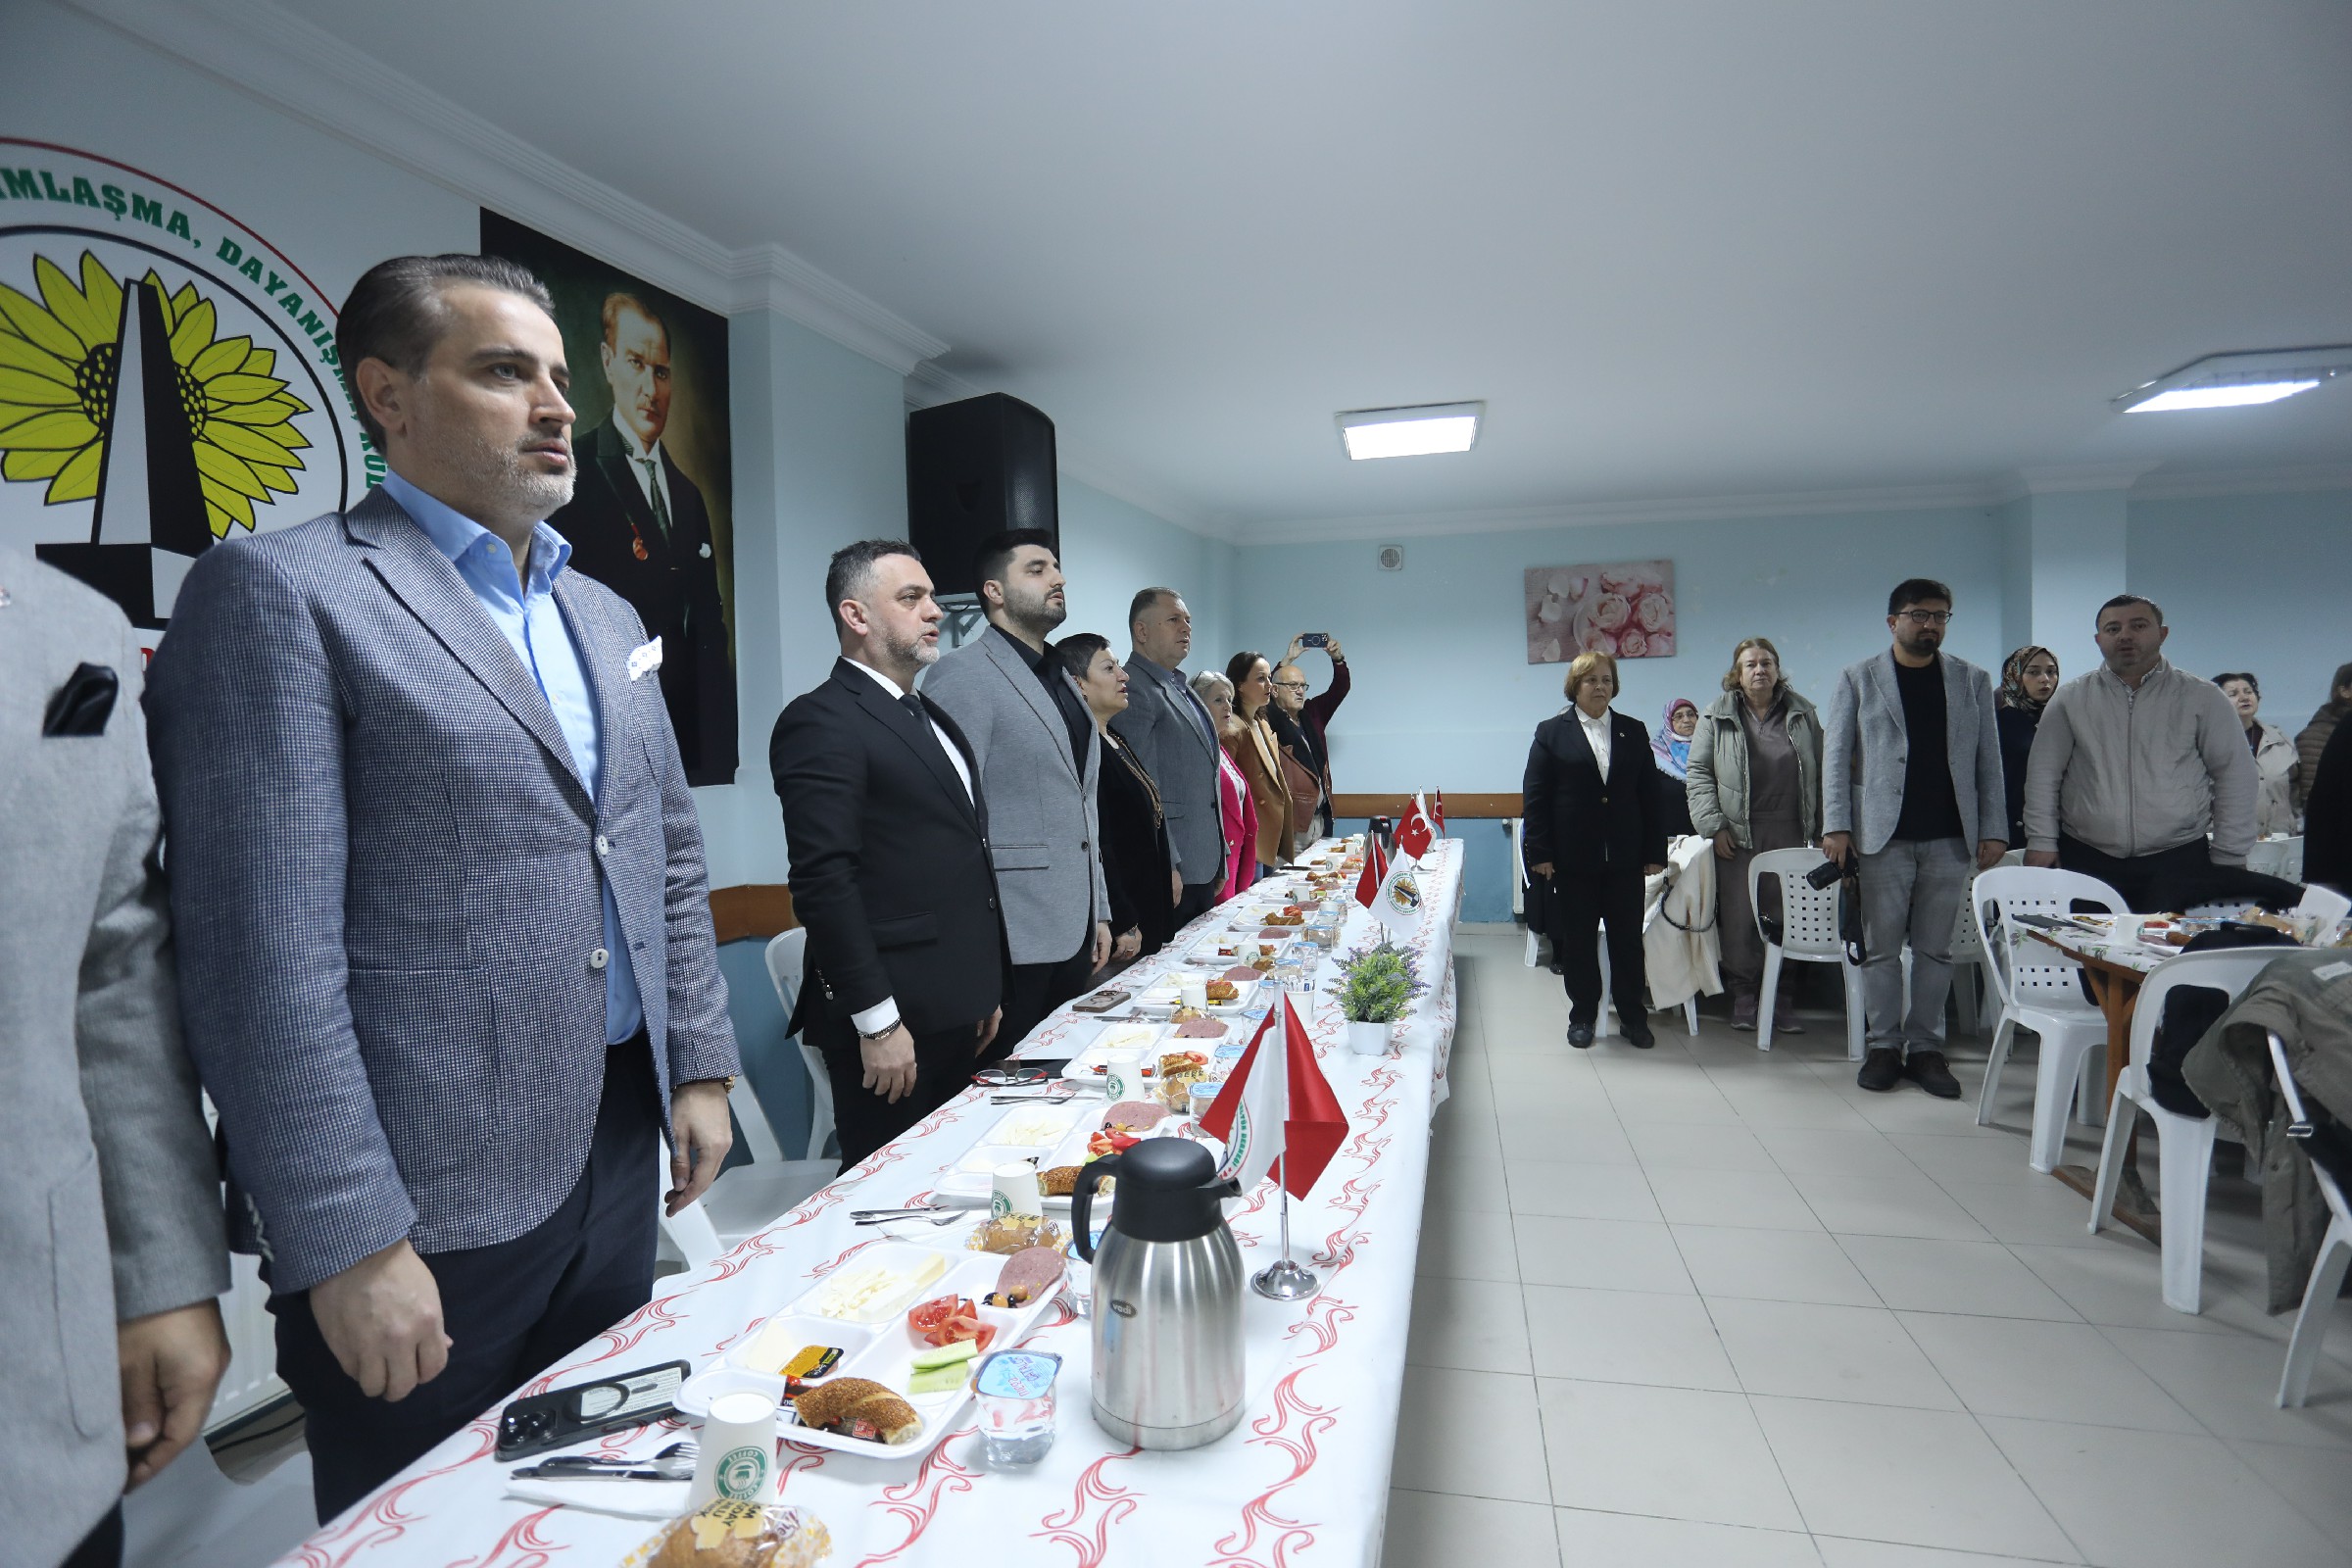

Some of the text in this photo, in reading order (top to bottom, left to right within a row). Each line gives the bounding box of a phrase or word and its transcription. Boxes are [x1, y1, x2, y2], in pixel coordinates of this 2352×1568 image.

[0, 168, 202, 249] MLAŞMA,
[1112, 1303, 1132, 1315] vadi
[728, 1450, 759, 1463] COFFEE
